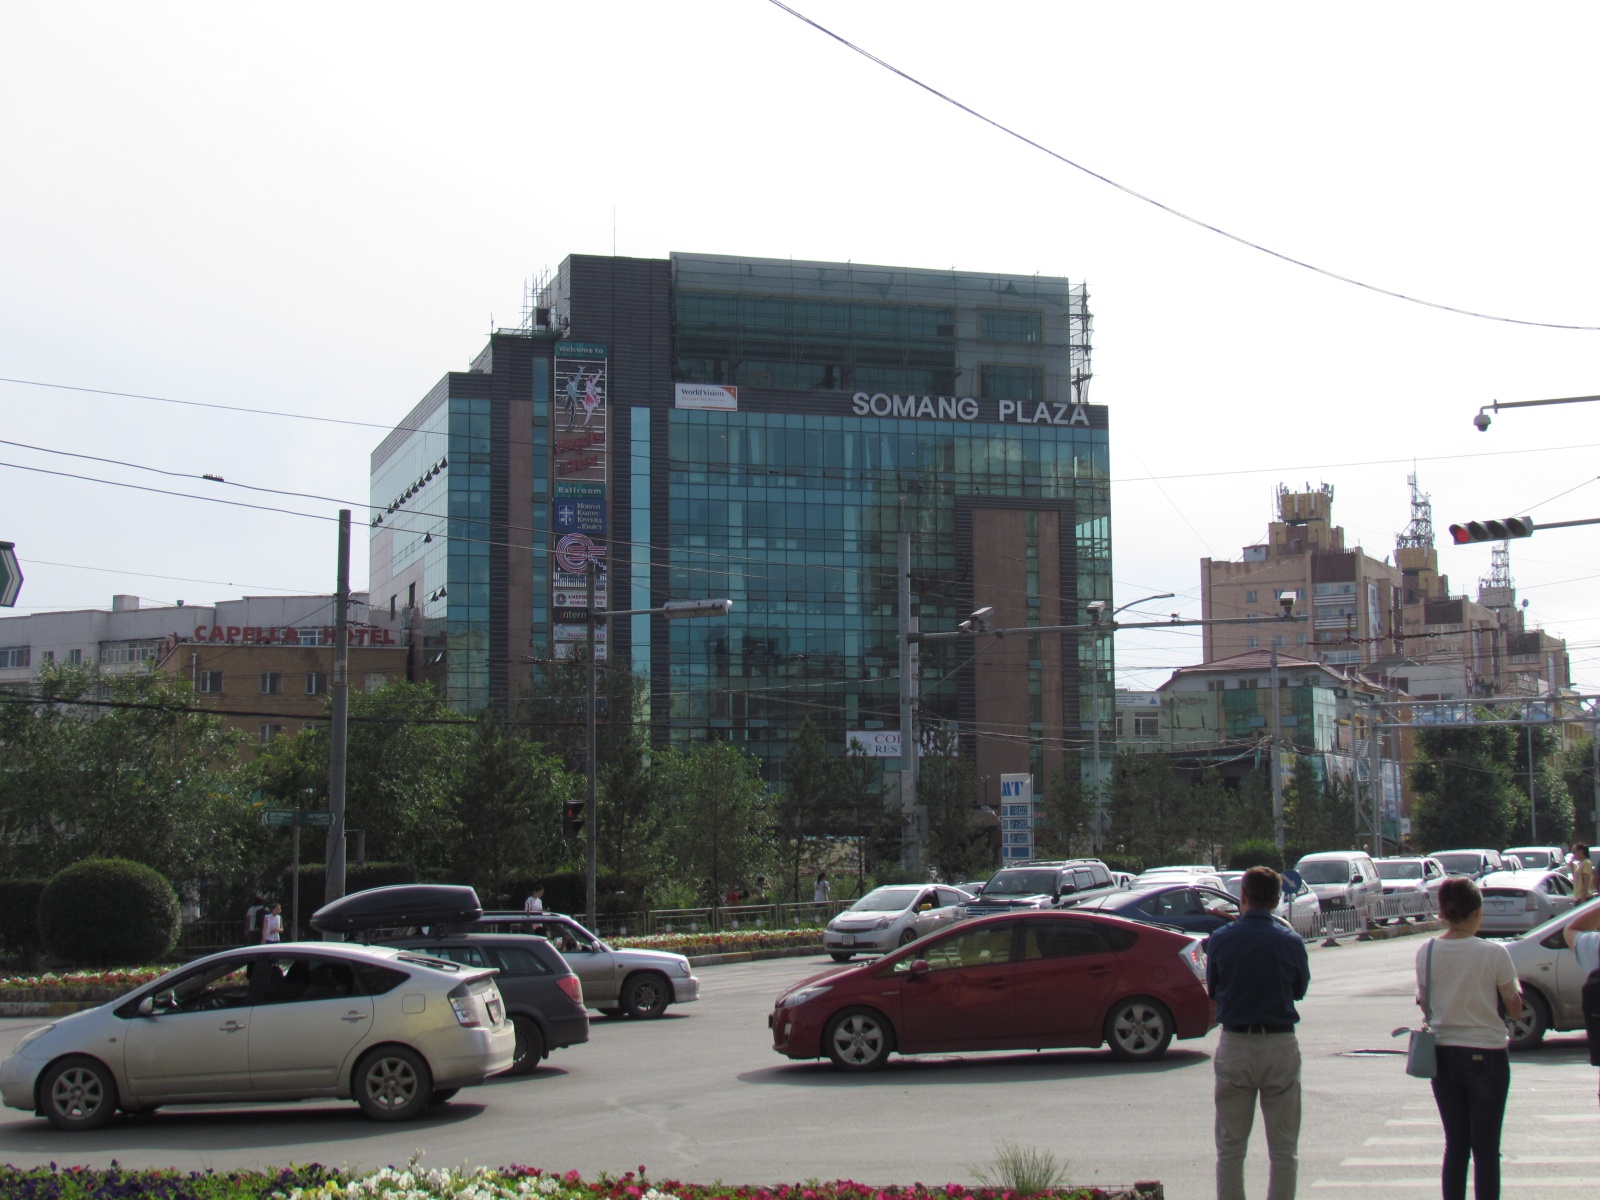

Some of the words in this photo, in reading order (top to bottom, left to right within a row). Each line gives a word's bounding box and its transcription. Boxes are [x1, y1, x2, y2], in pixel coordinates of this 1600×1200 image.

[558, 345, 593, 354] Welcome
[681, 388, 702, 396] World
[852, 392, 979, 420] SOMANG
[999, 400, 1089, 426] PLAZA
[557, 486, 602, 495] Ballroom
[194, 625, 299, 643] CAPELLA
